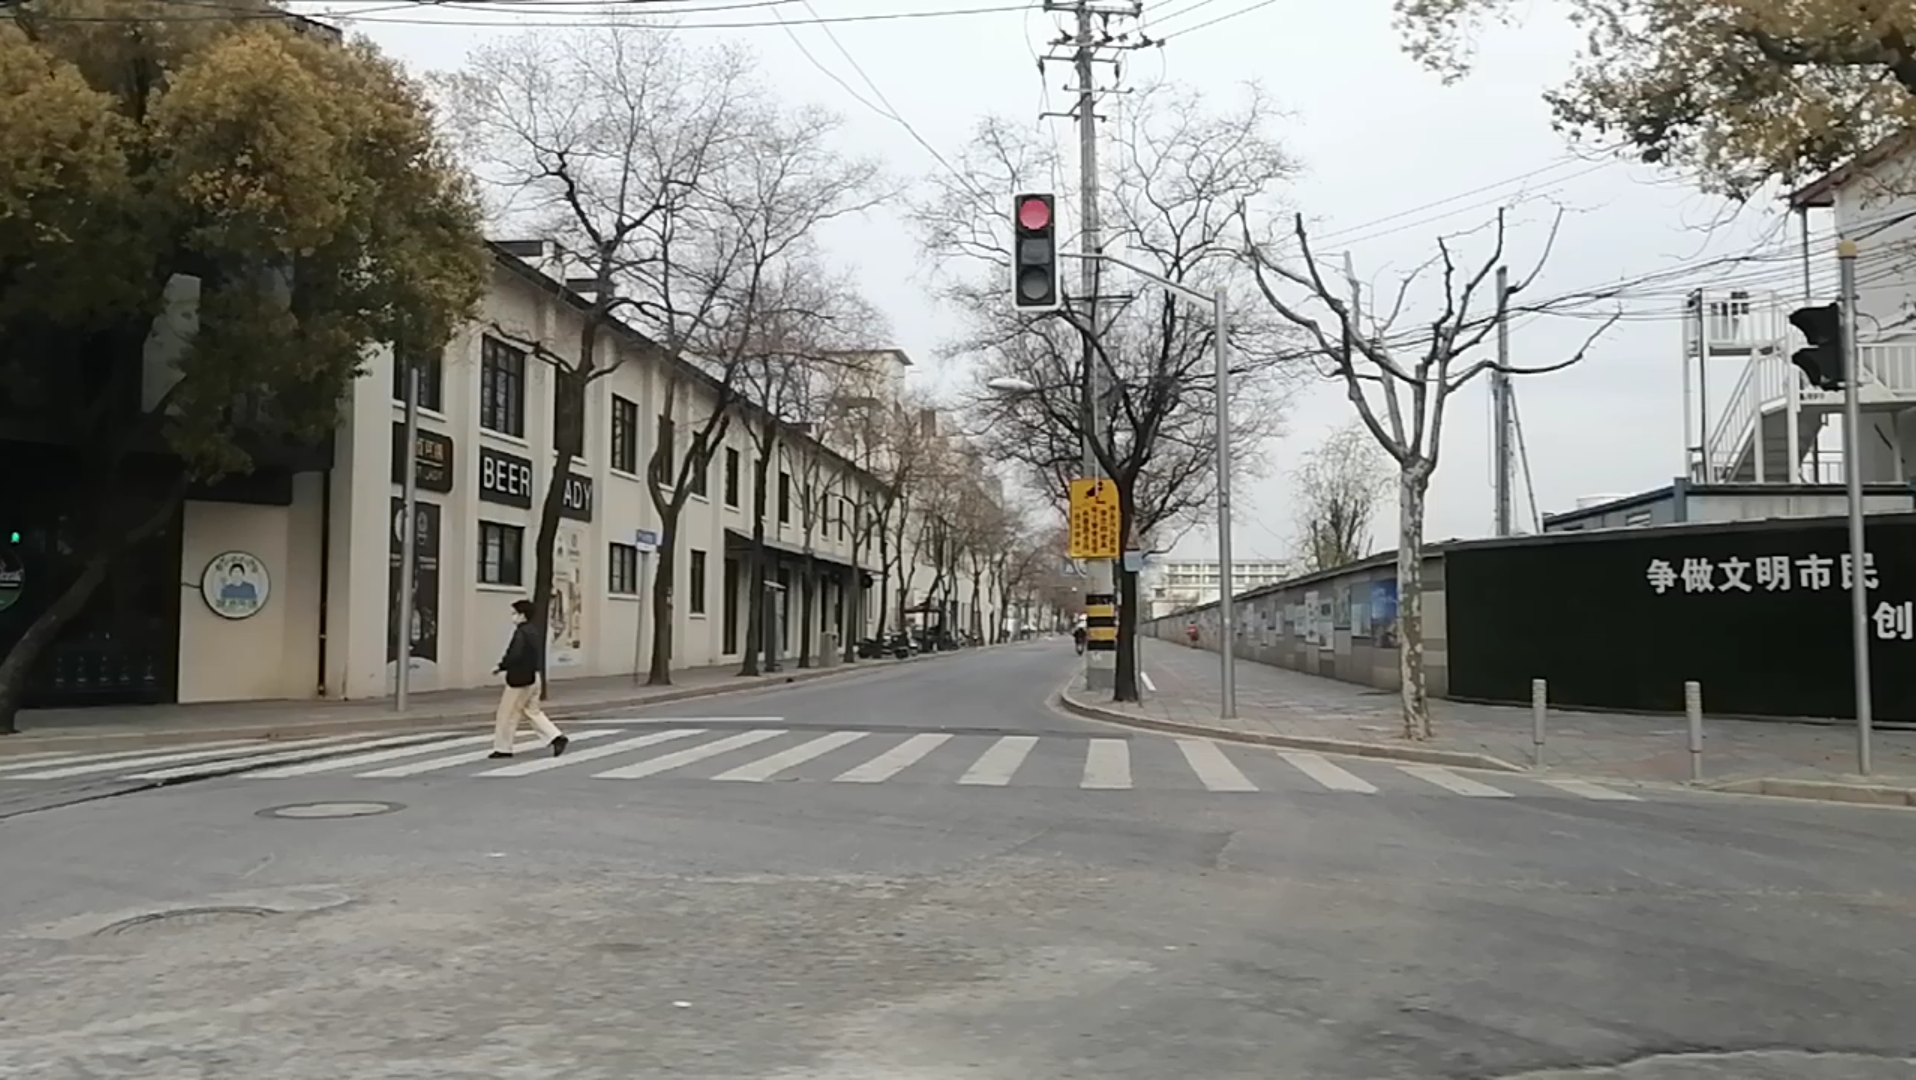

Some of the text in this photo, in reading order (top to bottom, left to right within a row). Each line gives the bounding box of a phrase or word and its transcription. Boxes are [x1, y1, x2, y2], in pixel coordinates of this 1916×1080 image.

[483, 456, 531, 497] BEER
[562, 479, 592, 511] ADY
[1645, 552, 1880, 594] 争做文明市民
[1872, 601, 1914, 640] 创
